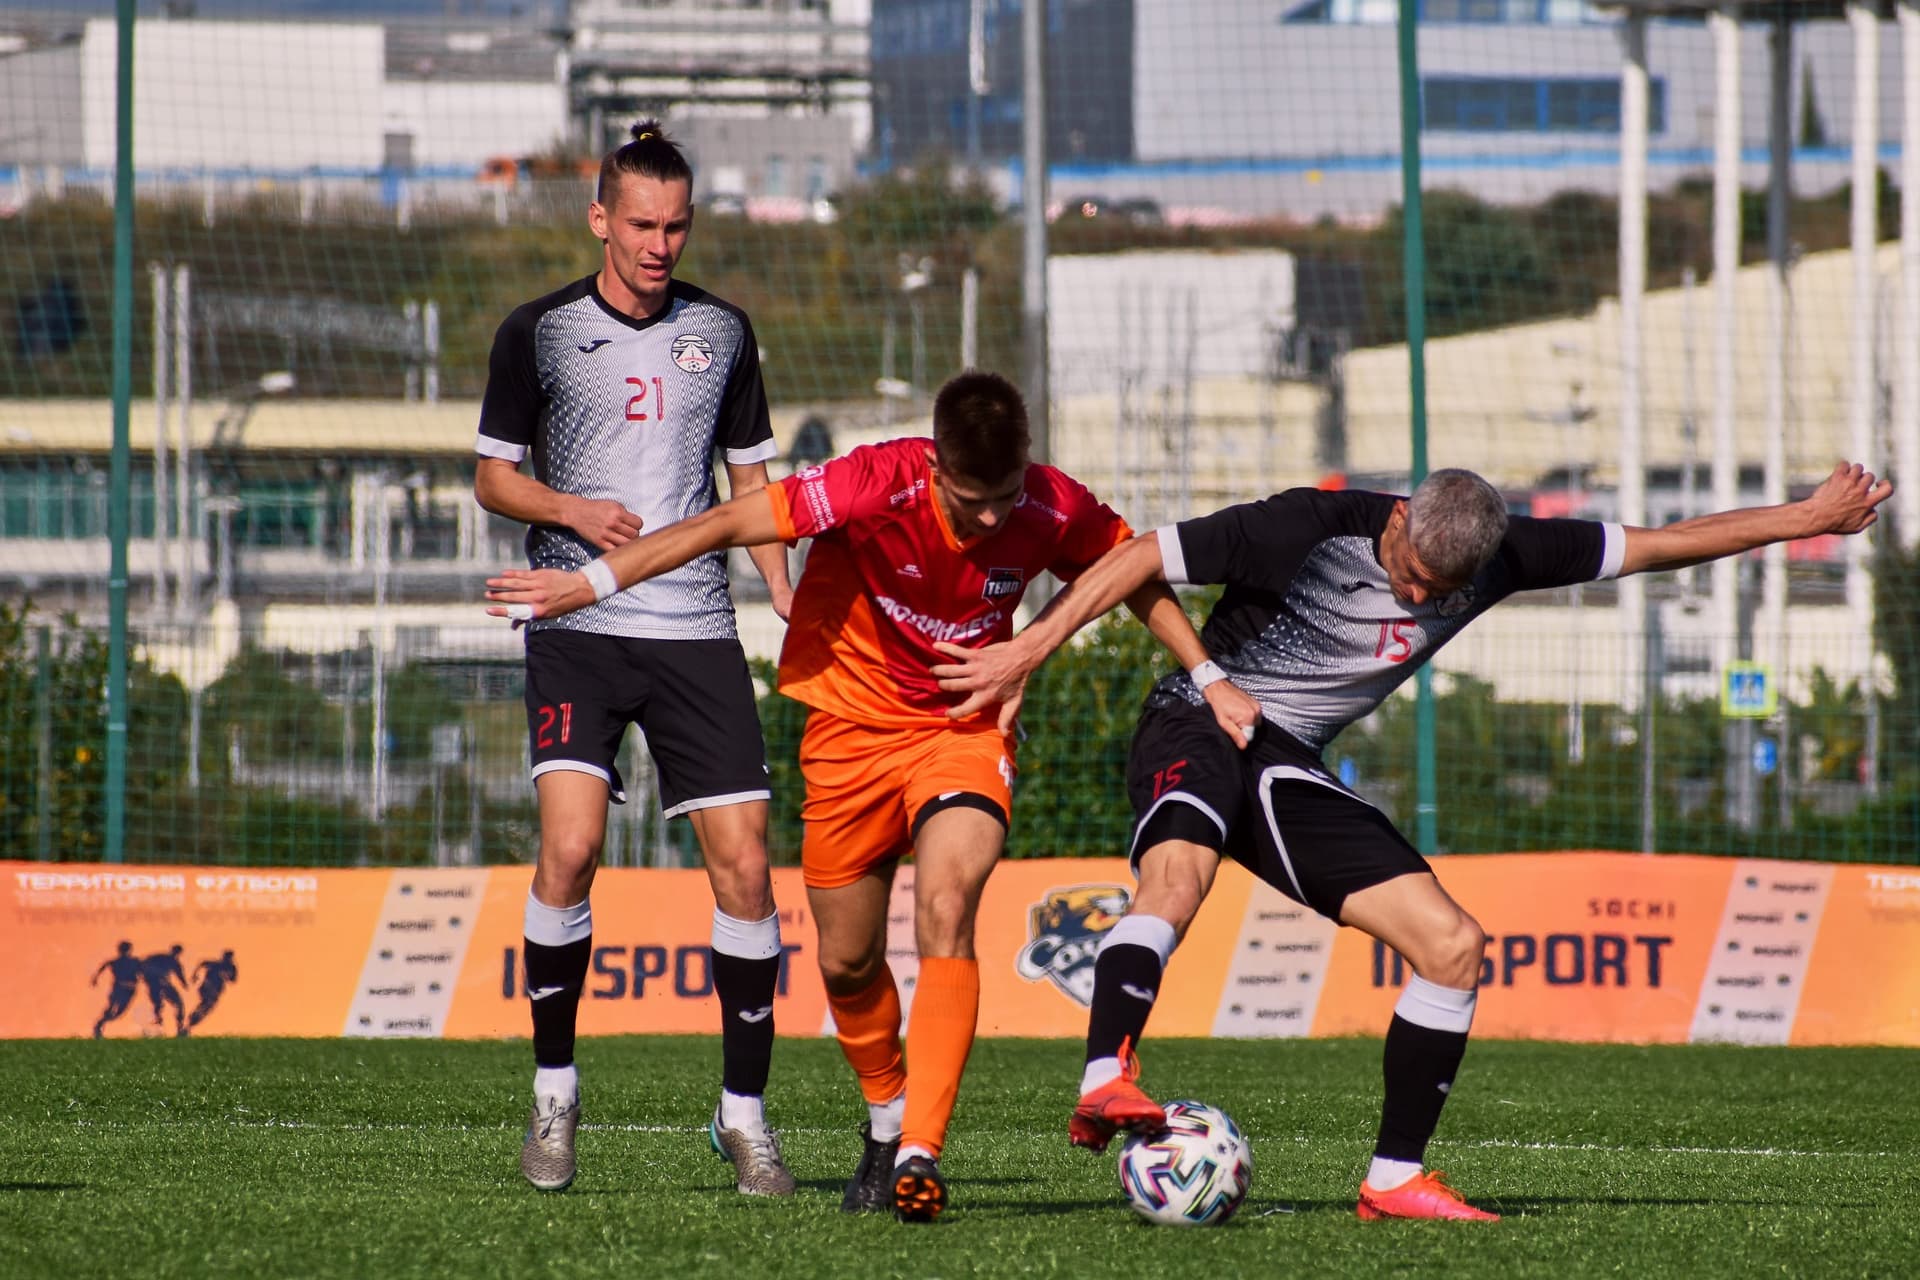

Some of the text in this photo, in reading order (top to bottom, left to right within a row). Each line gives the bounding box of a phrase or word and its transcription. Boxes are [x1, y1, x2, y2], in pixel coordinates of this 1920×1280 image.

[625, 376, 665, 421] 21
[1375, 618, 1417, 663] 15
[538, 703, 572, 749] 21
[1153, 759, 1188, 801] 15
[16, 872, 185, 891] ТЕРРИТОРИЯ
[503, 945, 802, 998] ISPOT
[1373, 934, 1674, 987] IPORT
